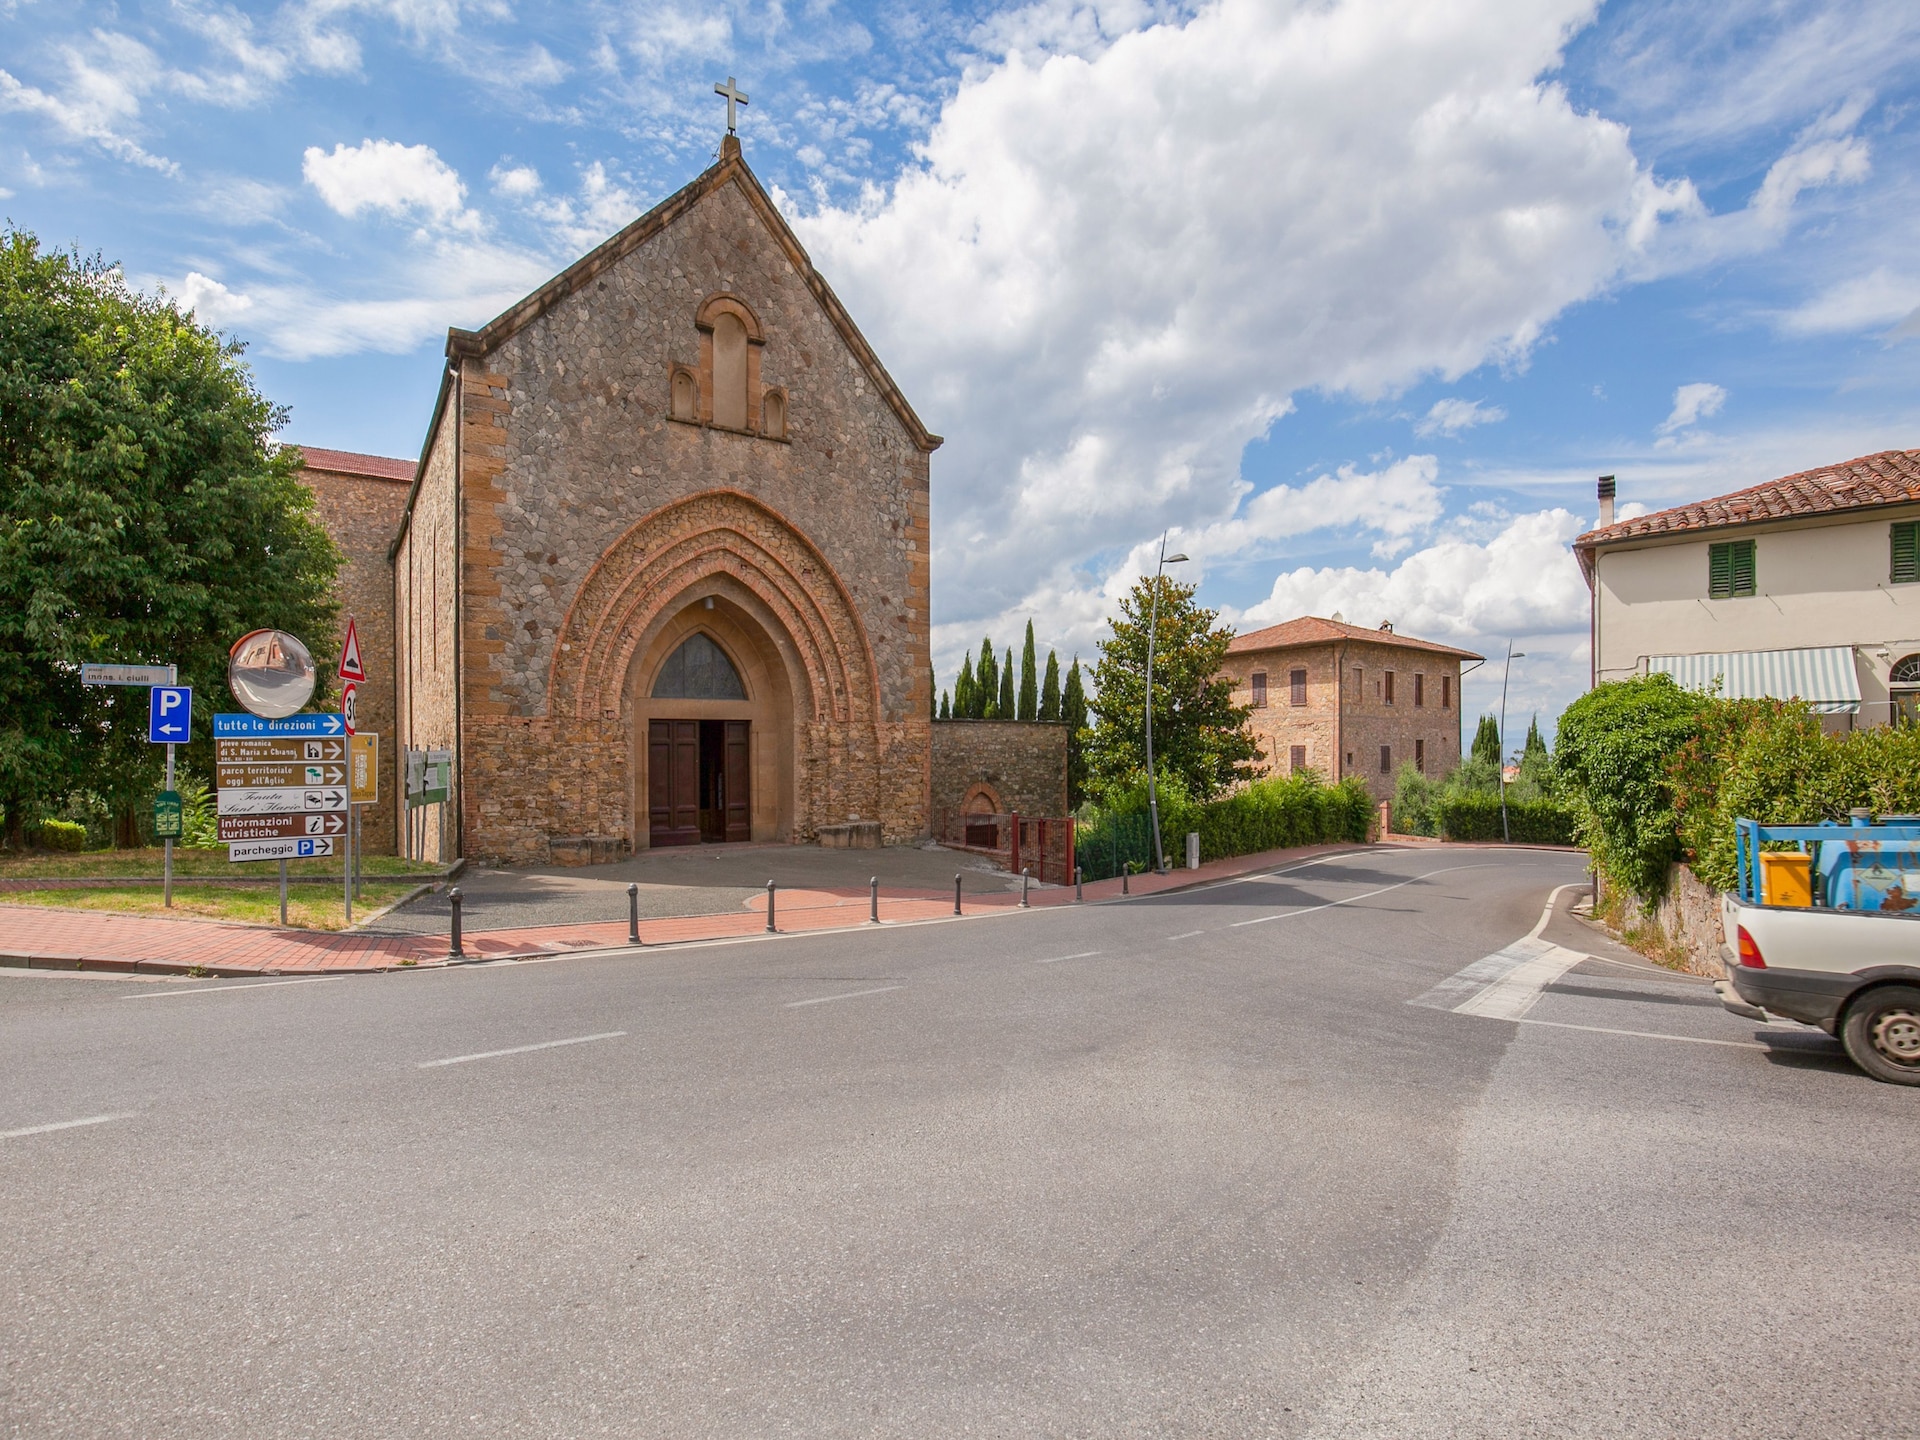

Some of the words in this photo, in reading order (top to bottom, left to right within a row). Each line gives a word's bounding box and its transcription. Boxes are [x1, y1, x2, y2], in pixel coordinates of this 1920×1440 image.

[160, 690, 182, 716] P
[218, 720, 248, 731] tutte
[252, 719, 264, 730] le
[268, 719, 316, 731] direzioni
[220, 740, 239, 748] pieve
[240, 748, 260, 756] Maria
[221, 767, 244, 776] parco
[247, 766, 292, 775] territoriale
[226, 777, 244, 787] oggi
[251, 776, 285, 786] all'Aglio
[239, 791, 282, 801] Tenuta
[221, 817, 293, 828] informazioni
[221, 828, 279, 839] turistiche
[234, 844, 293, 857] parcheggio
[301, 841, 311, 854] P
